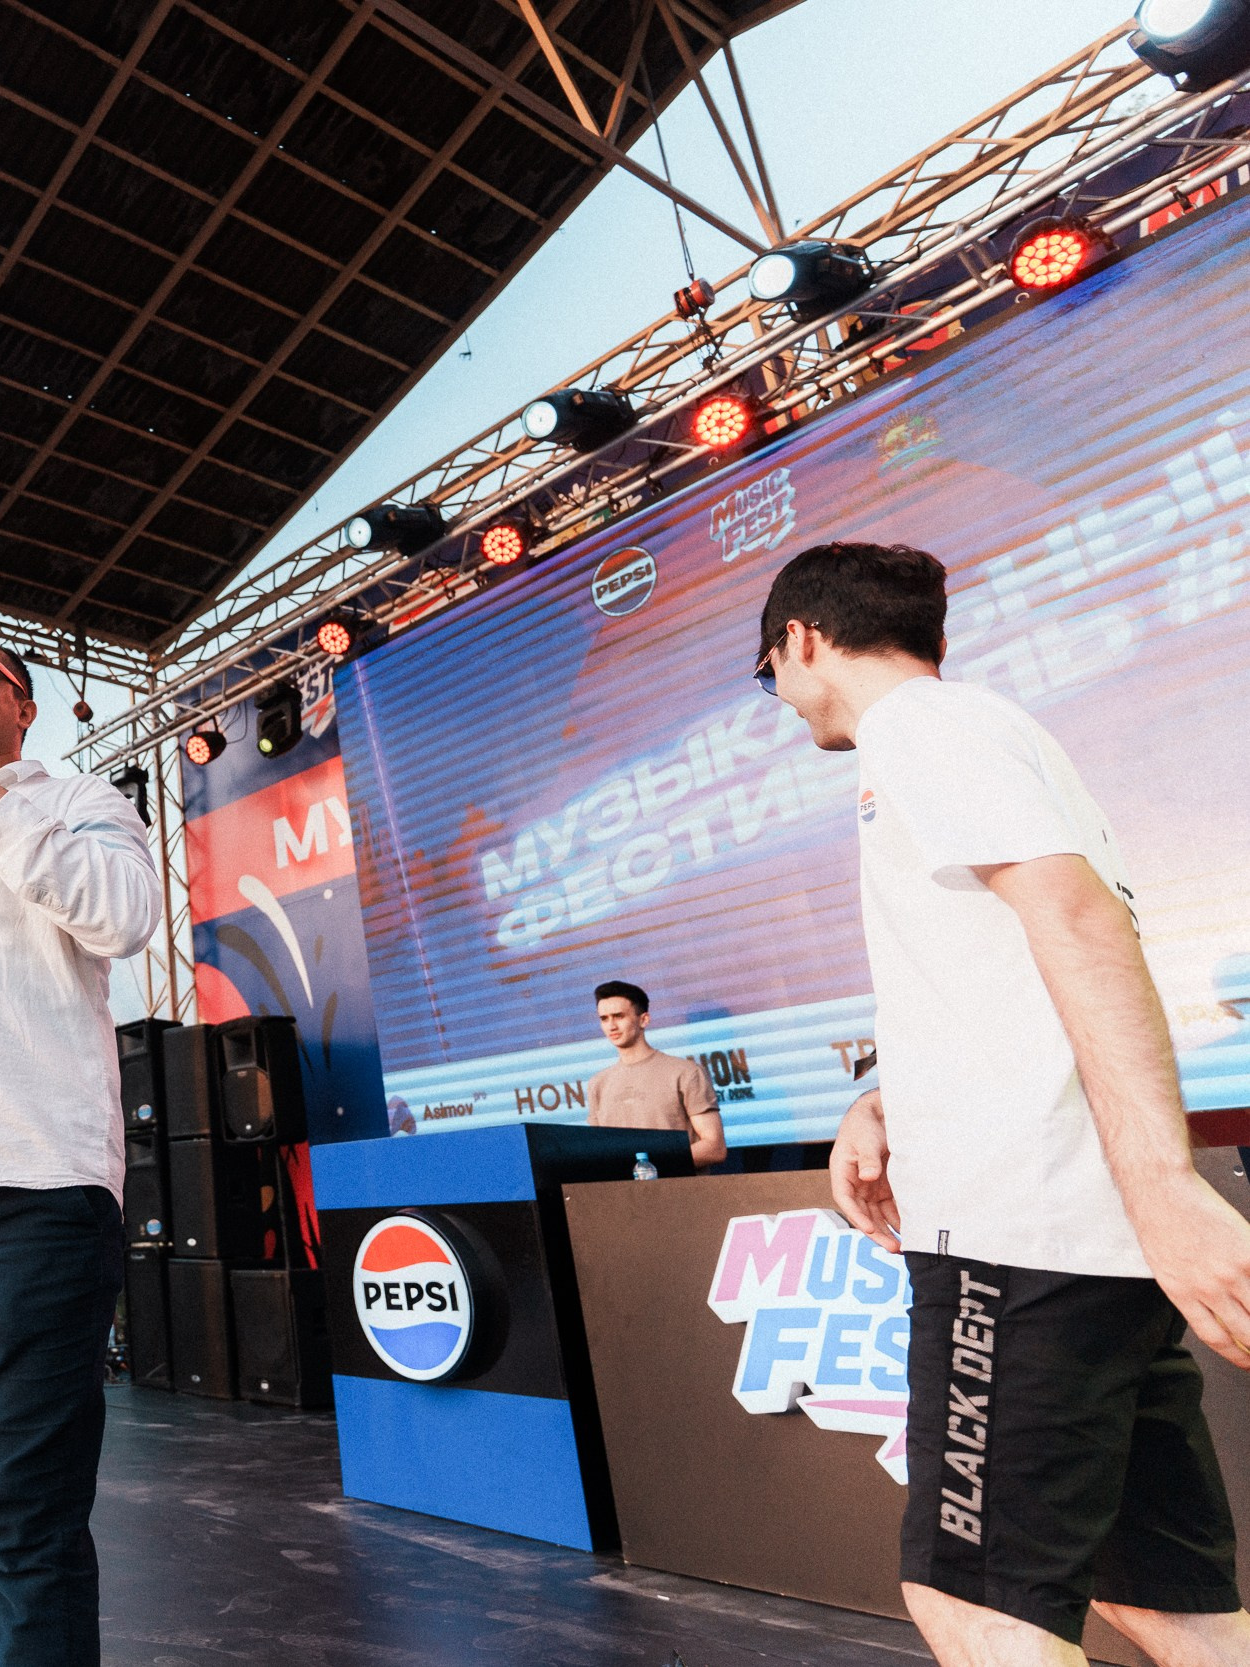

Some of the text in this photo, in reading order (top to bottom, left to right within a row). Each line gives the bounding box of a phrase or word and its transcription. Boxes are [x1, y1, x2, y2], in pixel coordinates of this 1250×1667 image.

[712, 468, 791, 538] MUSIC
[723, 488, 794, 560] FEST
[595, 563, 653, 600] PEPSI
[860, 800, 876, 812] PEPS
[423, 1102, 474, 1121] Asimov
[514, 1080, 587, 1115] HON
[715, 1214, 913, 1305] MUS
[362, 1280, 460, 1313] PEPSI
[739, 1307, 911, 1393] FES
[939, 1383, 990, 1546] BLACK
